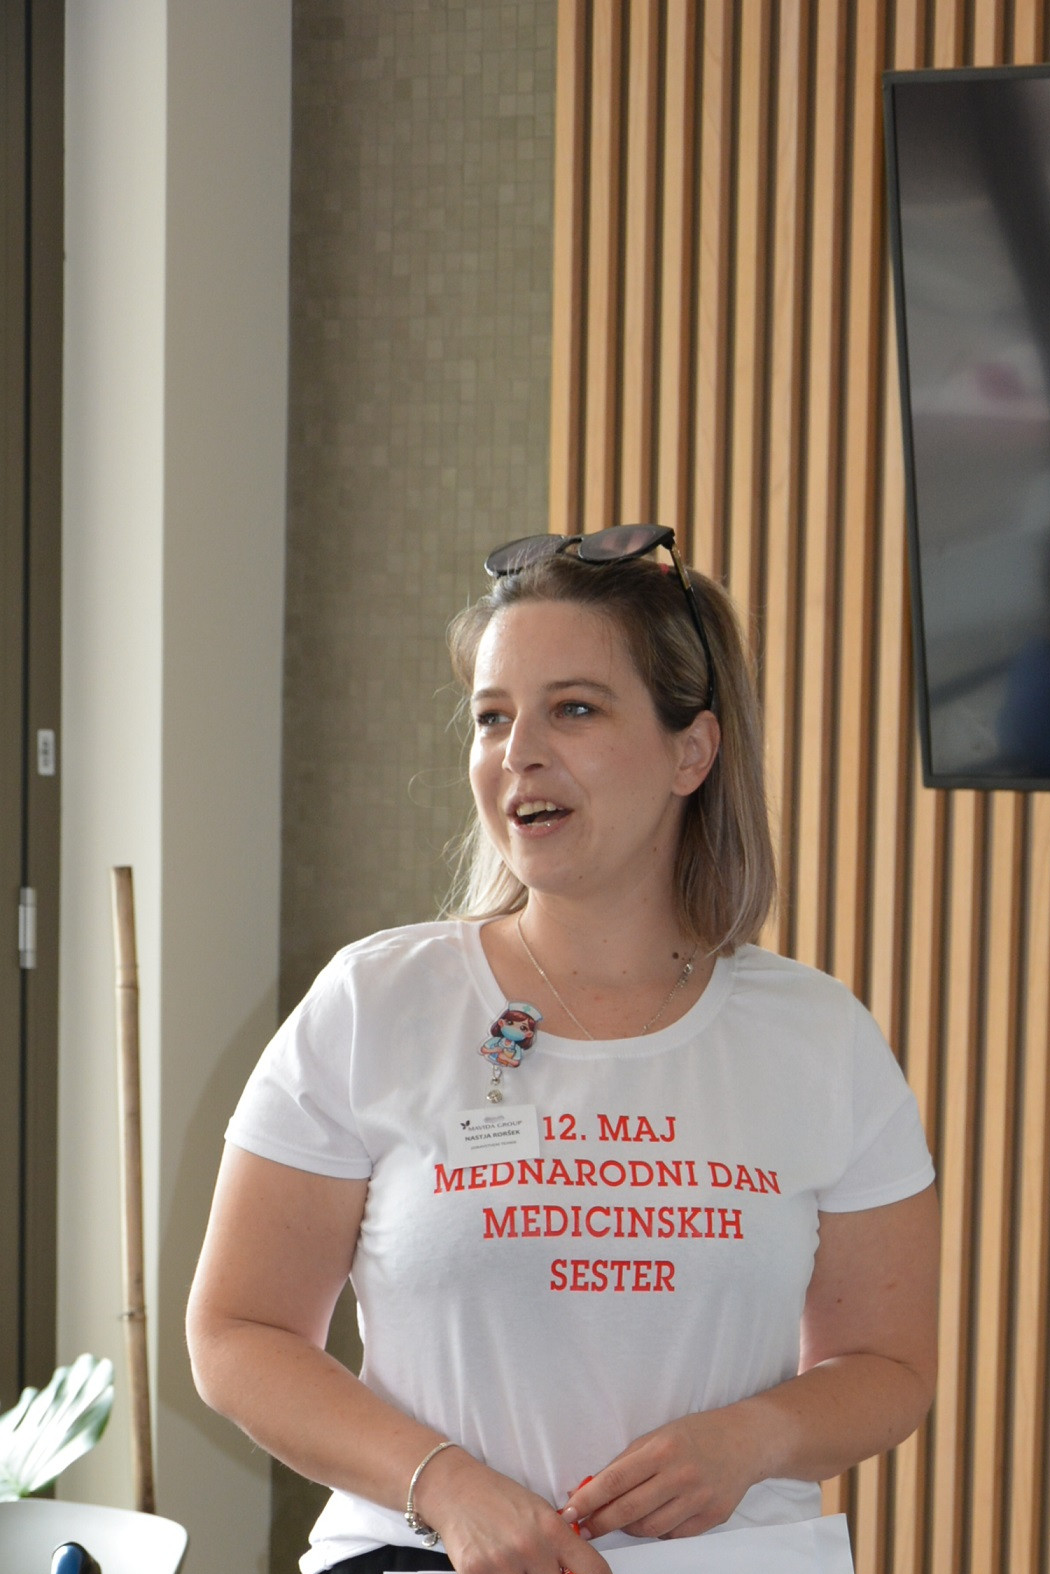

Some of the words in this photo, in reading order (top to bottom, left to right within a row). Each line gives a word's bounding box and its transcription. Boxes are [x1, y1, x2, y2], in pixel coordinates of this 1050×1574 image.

[543, 1114, 586, 1141] 12.
[598, 1114, 676, 1143] MAJ
[434, 1158, 698, 1194] MEDNARODNI
[707, 1160, 781, 1195] DAN
[482, 1206, 744, 1239] MEDICINSKIH
[550, 1259, 675, 1292] SESTER
